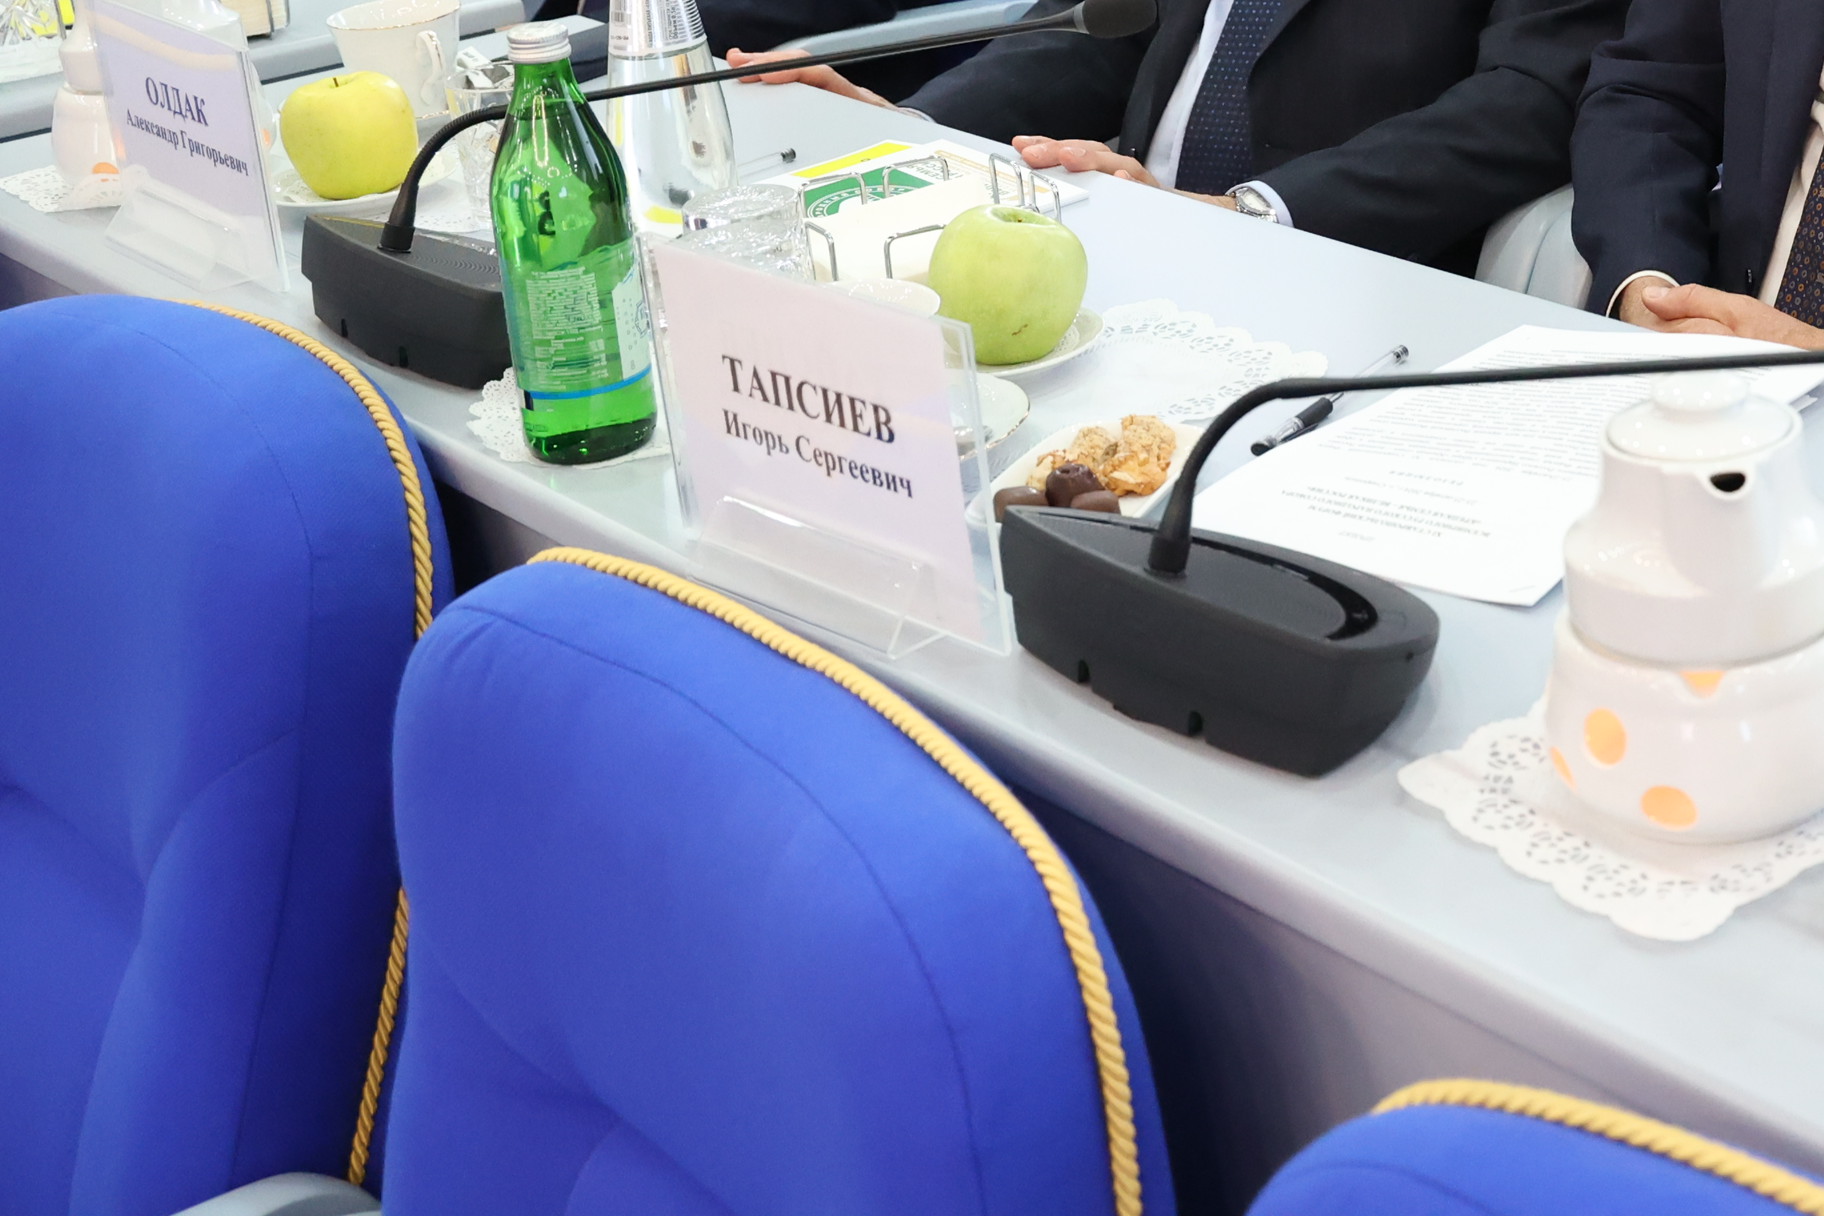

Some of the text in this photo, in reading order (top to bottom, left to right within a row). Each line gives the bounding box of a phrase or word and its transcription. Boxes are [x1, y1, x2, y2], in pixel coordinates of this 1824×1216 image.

[145, 76, 209, 126] ОЛДАК
[126, 108, 249, 176] Александр Григорьевич
[721, 354, 896, 444] ТАПСИЕВ
[722, 408, 914, 498] Игорь Сергеевич
